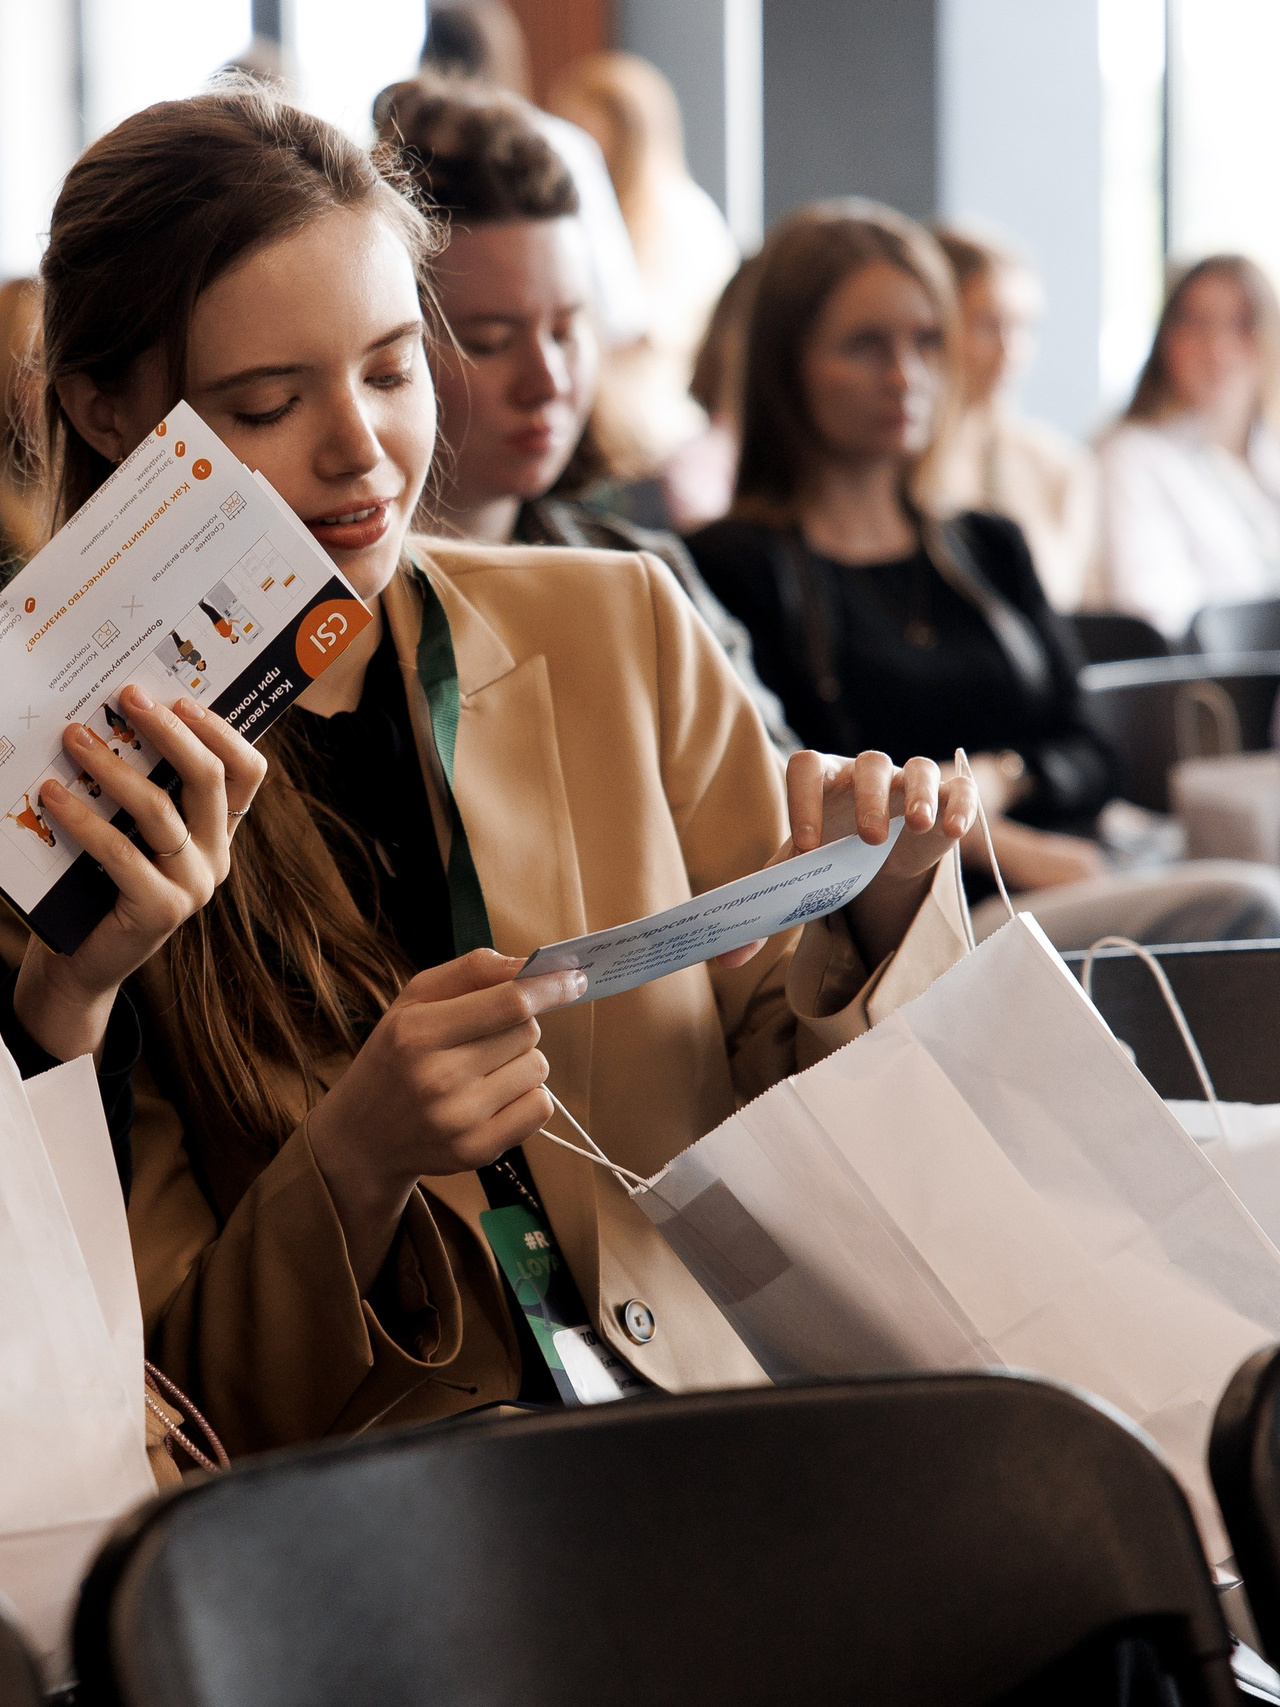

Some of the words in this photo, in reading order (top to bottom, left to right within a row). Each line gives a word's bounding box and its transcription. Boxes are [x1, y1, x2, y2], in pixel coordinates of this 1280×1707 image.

[134, 449, 166, 481] скидками.
[137, 456, 174, 494] Запускайте
[118, 493, 137, 515] акции
[169, 481, 190, 502] Как
[79, 519, 114, 555] «тающими»
[121, 500, 170, 550] увеличить
[179, 513, 218, 553] количество
[194, 521, 224, 552] Среднее
[67, 551, 121, 606] количество
[151, 553, 179, 582] визитов
[25, 605, 67, 652] визитов?
[130, 618, 163, 651] Формула
[309, 612, 347, 653] CSI
[48, 642, 91, 688] покупателей
[58, 650, 98, 692] Количество
[99, 650, 130, 683] выручки
[258, 667, 280, 690] при
[90, 682, 100, 692] за
[268, 679, 293, 702] Как
[64, 692, 91, 720] период
[238, 700, 269, 735] увели
[587, 943, 612, 954] По
[614, 914, 699, 948] вопросам
[703, 863, 833, 917] сотрудничества
[612, 945, 661, 967] Telegram
[671, 936, 699, 949] Viber
[708, 916, 761, 937] WhatsApp
[620, 947, 646, 958] +375
[523, 1230, 550, 1250] #R
